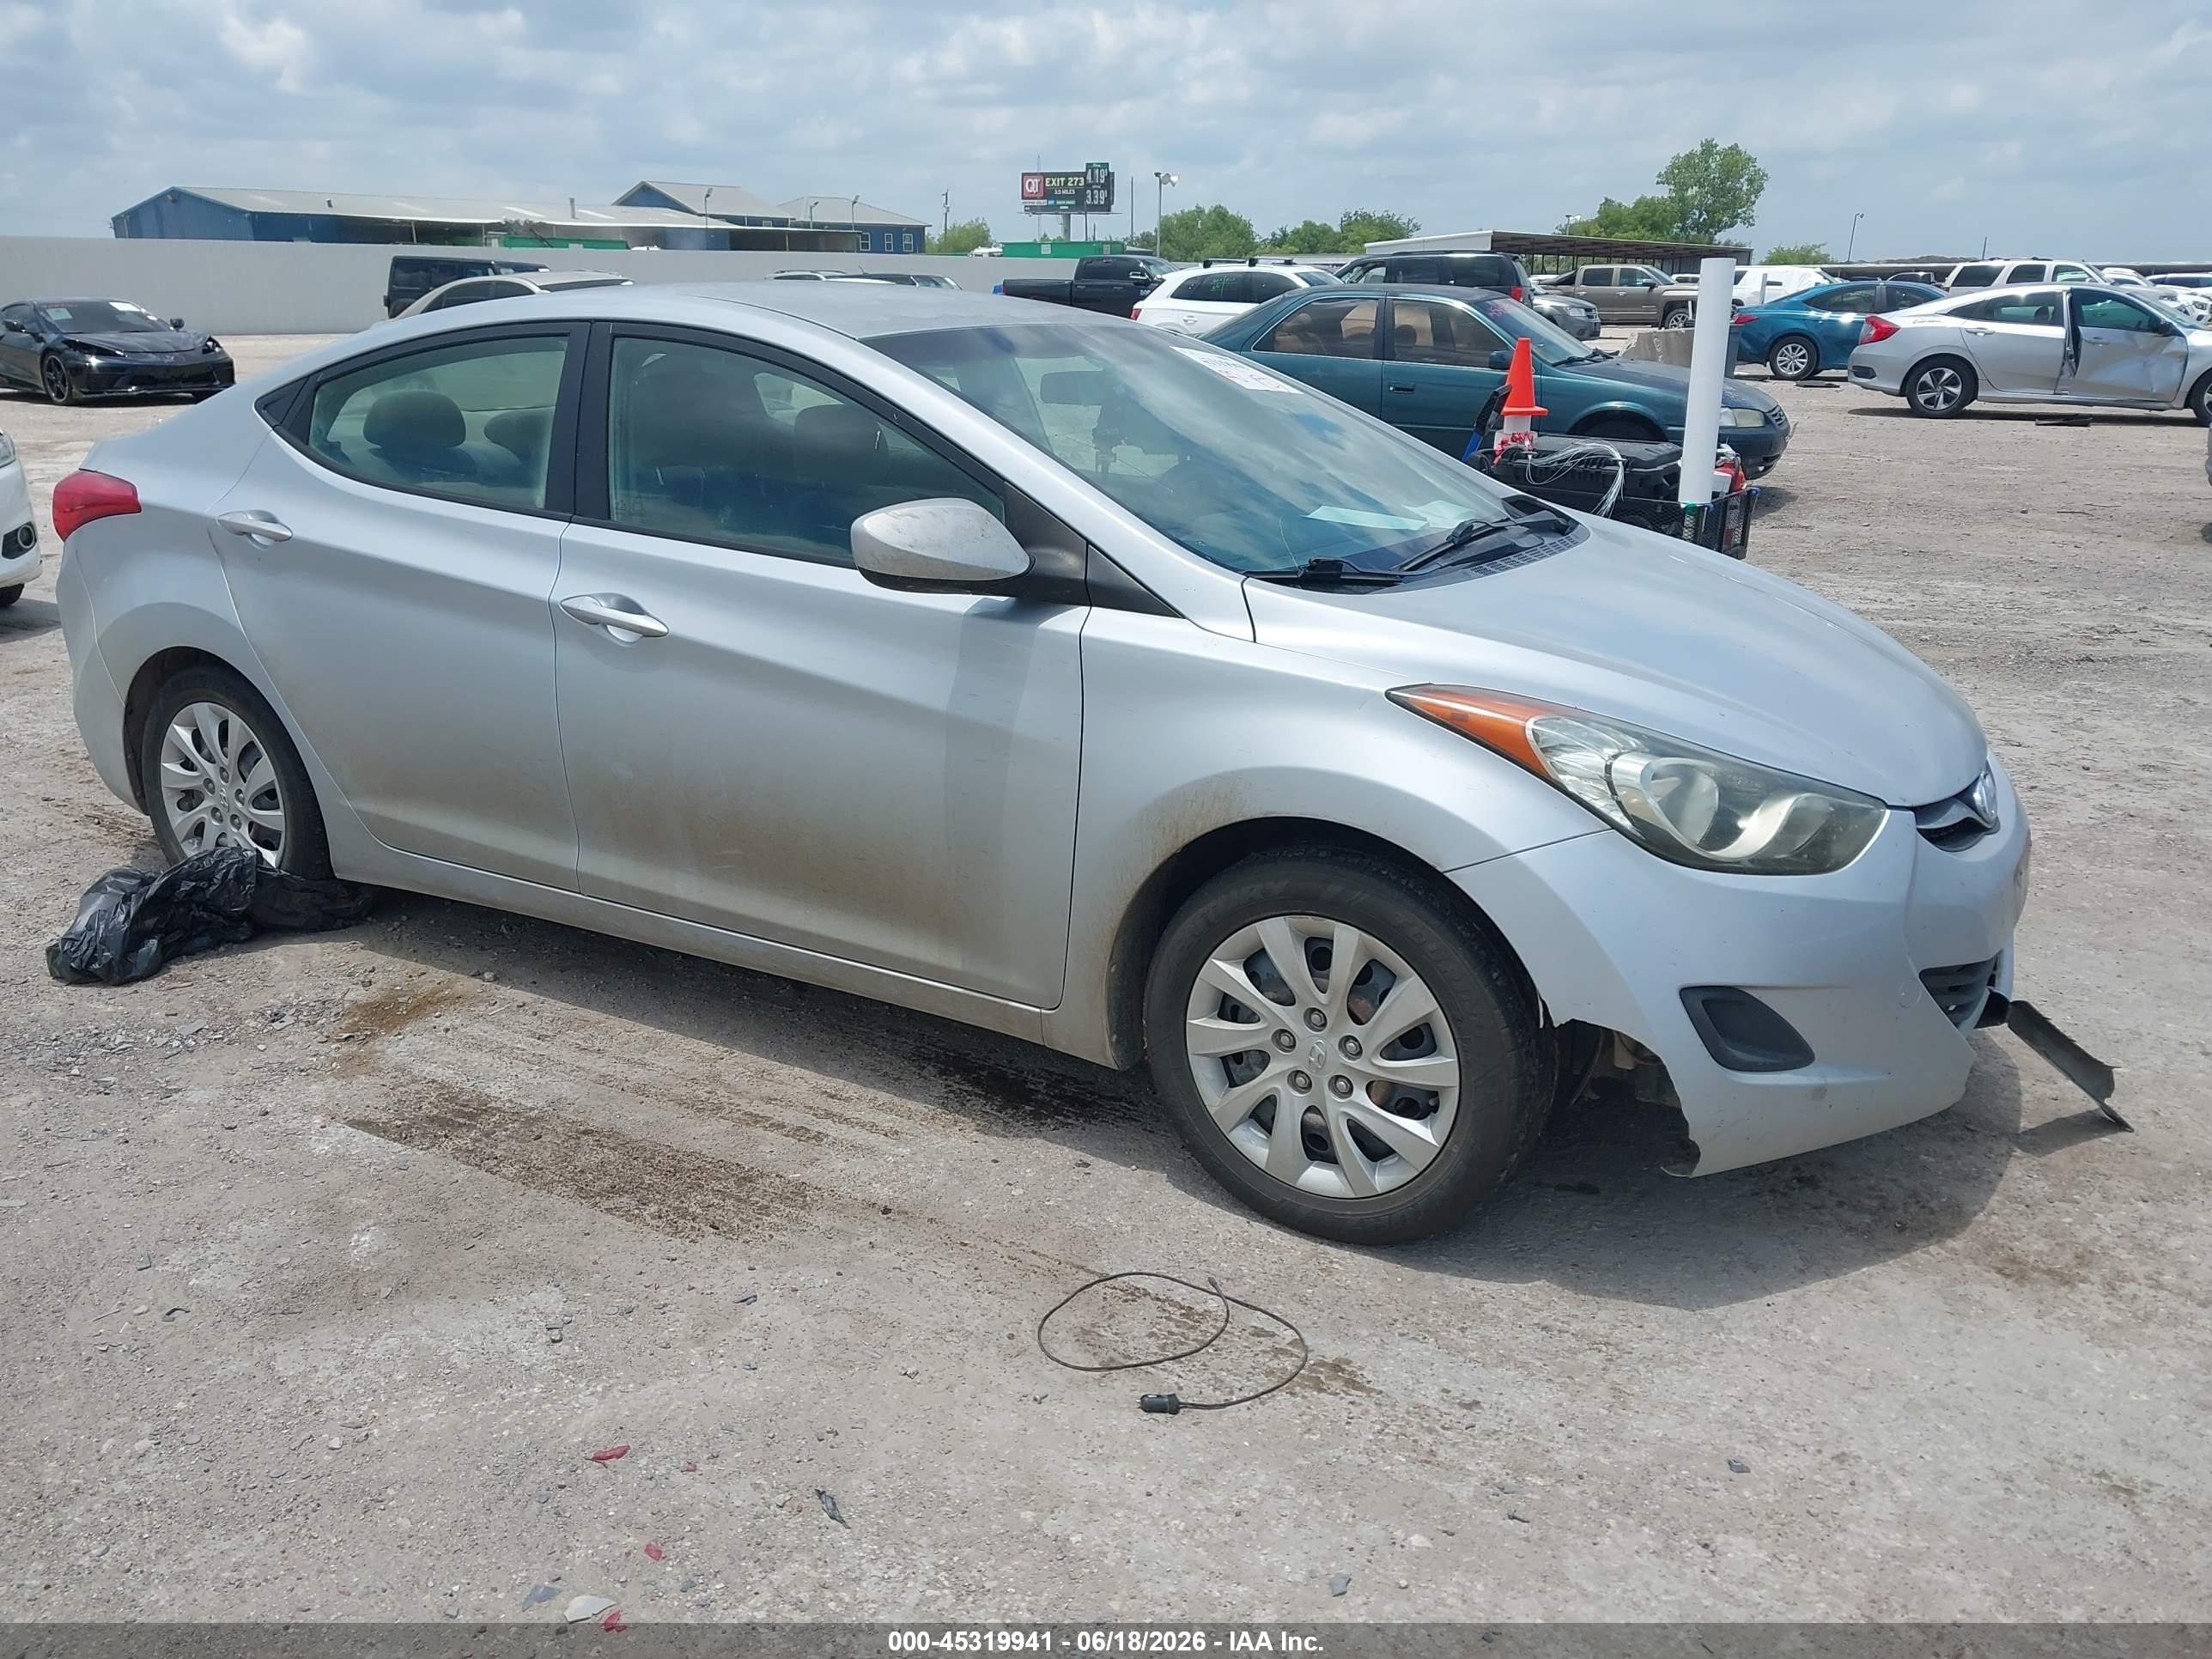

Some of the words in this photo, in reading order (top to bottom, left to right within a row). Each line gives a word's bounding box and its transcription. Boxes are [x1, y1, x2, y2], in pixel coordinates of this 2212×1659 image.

[1025, 179, 1040, 194] QT
[1045, 177, 1066, 186] EXIT
[1067, 177, 1085, 186] 273
